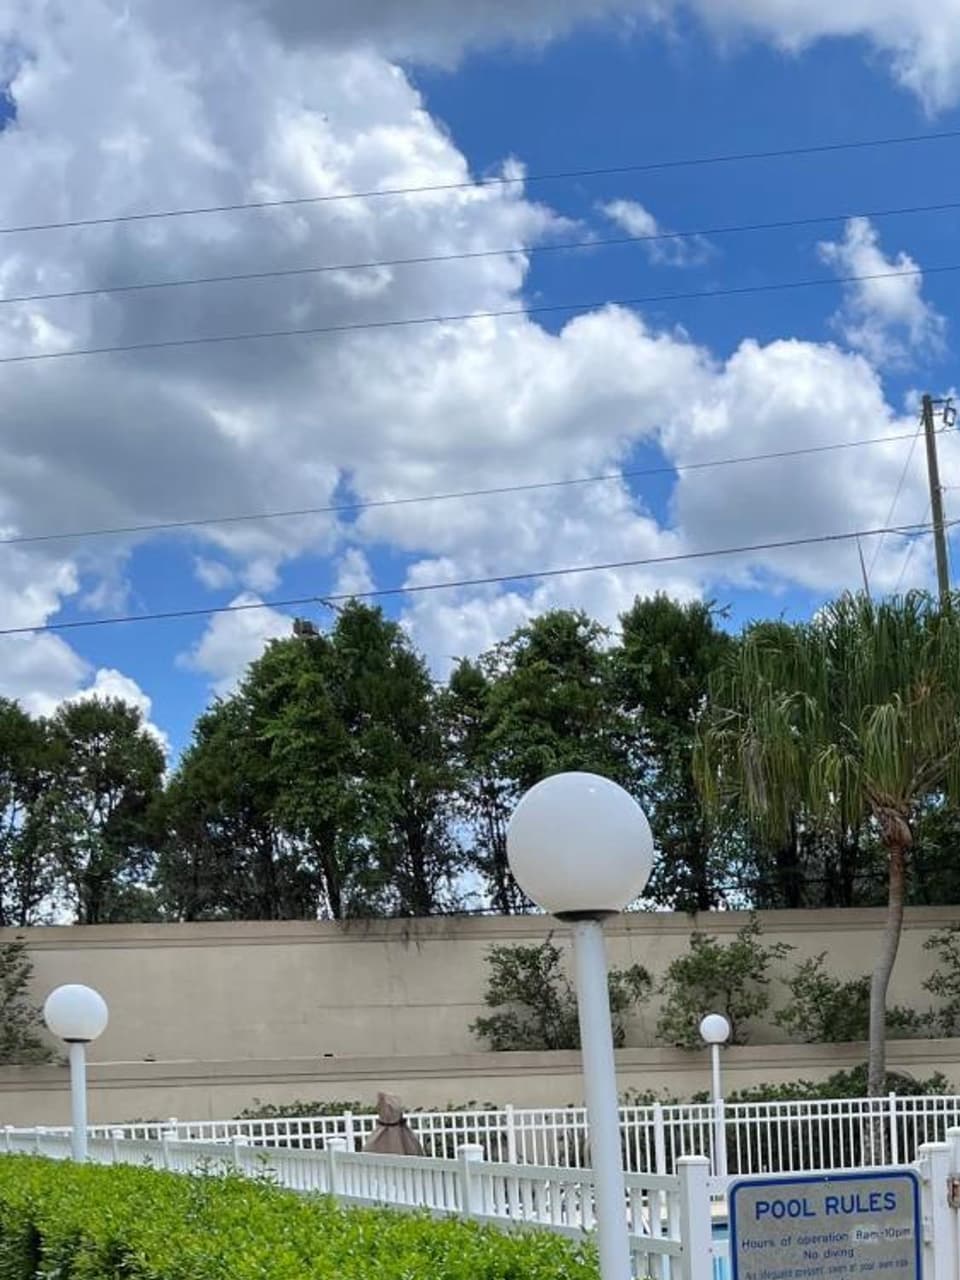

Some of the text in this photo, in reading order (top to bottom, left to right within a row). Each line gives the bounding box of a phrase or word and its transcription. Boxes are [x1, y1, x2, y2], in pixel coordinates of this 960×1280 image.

[755, 1192, 897, 1220] POOL RULES
[742, 1239, 775, 1249] Hours
[780, 1236, 792, 1247] of
[797, 1232, 849, 1246] operation
[804, 1248, 854, 1259] No diving
